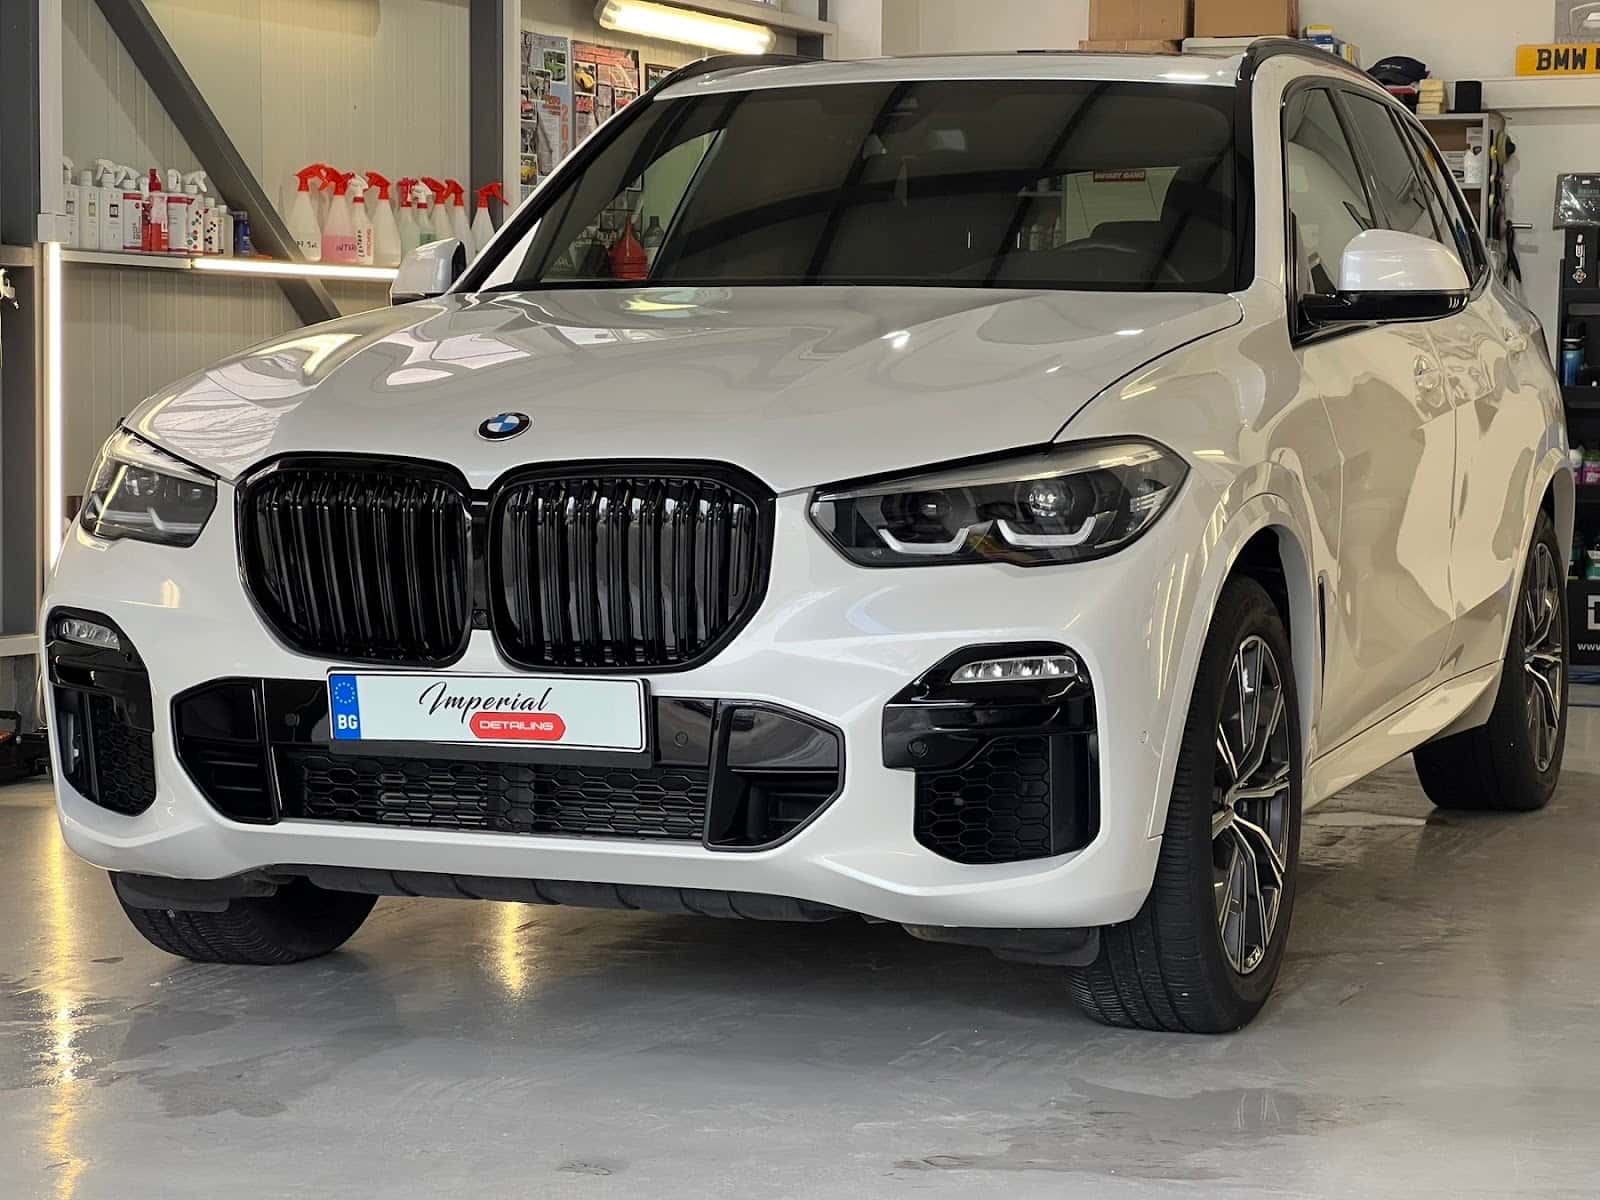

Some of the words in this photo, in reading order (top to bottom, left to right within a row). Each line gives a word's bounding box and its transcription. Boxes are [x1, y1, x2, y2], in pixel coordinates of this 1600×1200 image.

[1536, 48, 1587, 70] BMW
[419, 681, 553, 724] Imperial
[338, 714, 358, 729] BG
[479, 720, 554, 731] DETAILING
